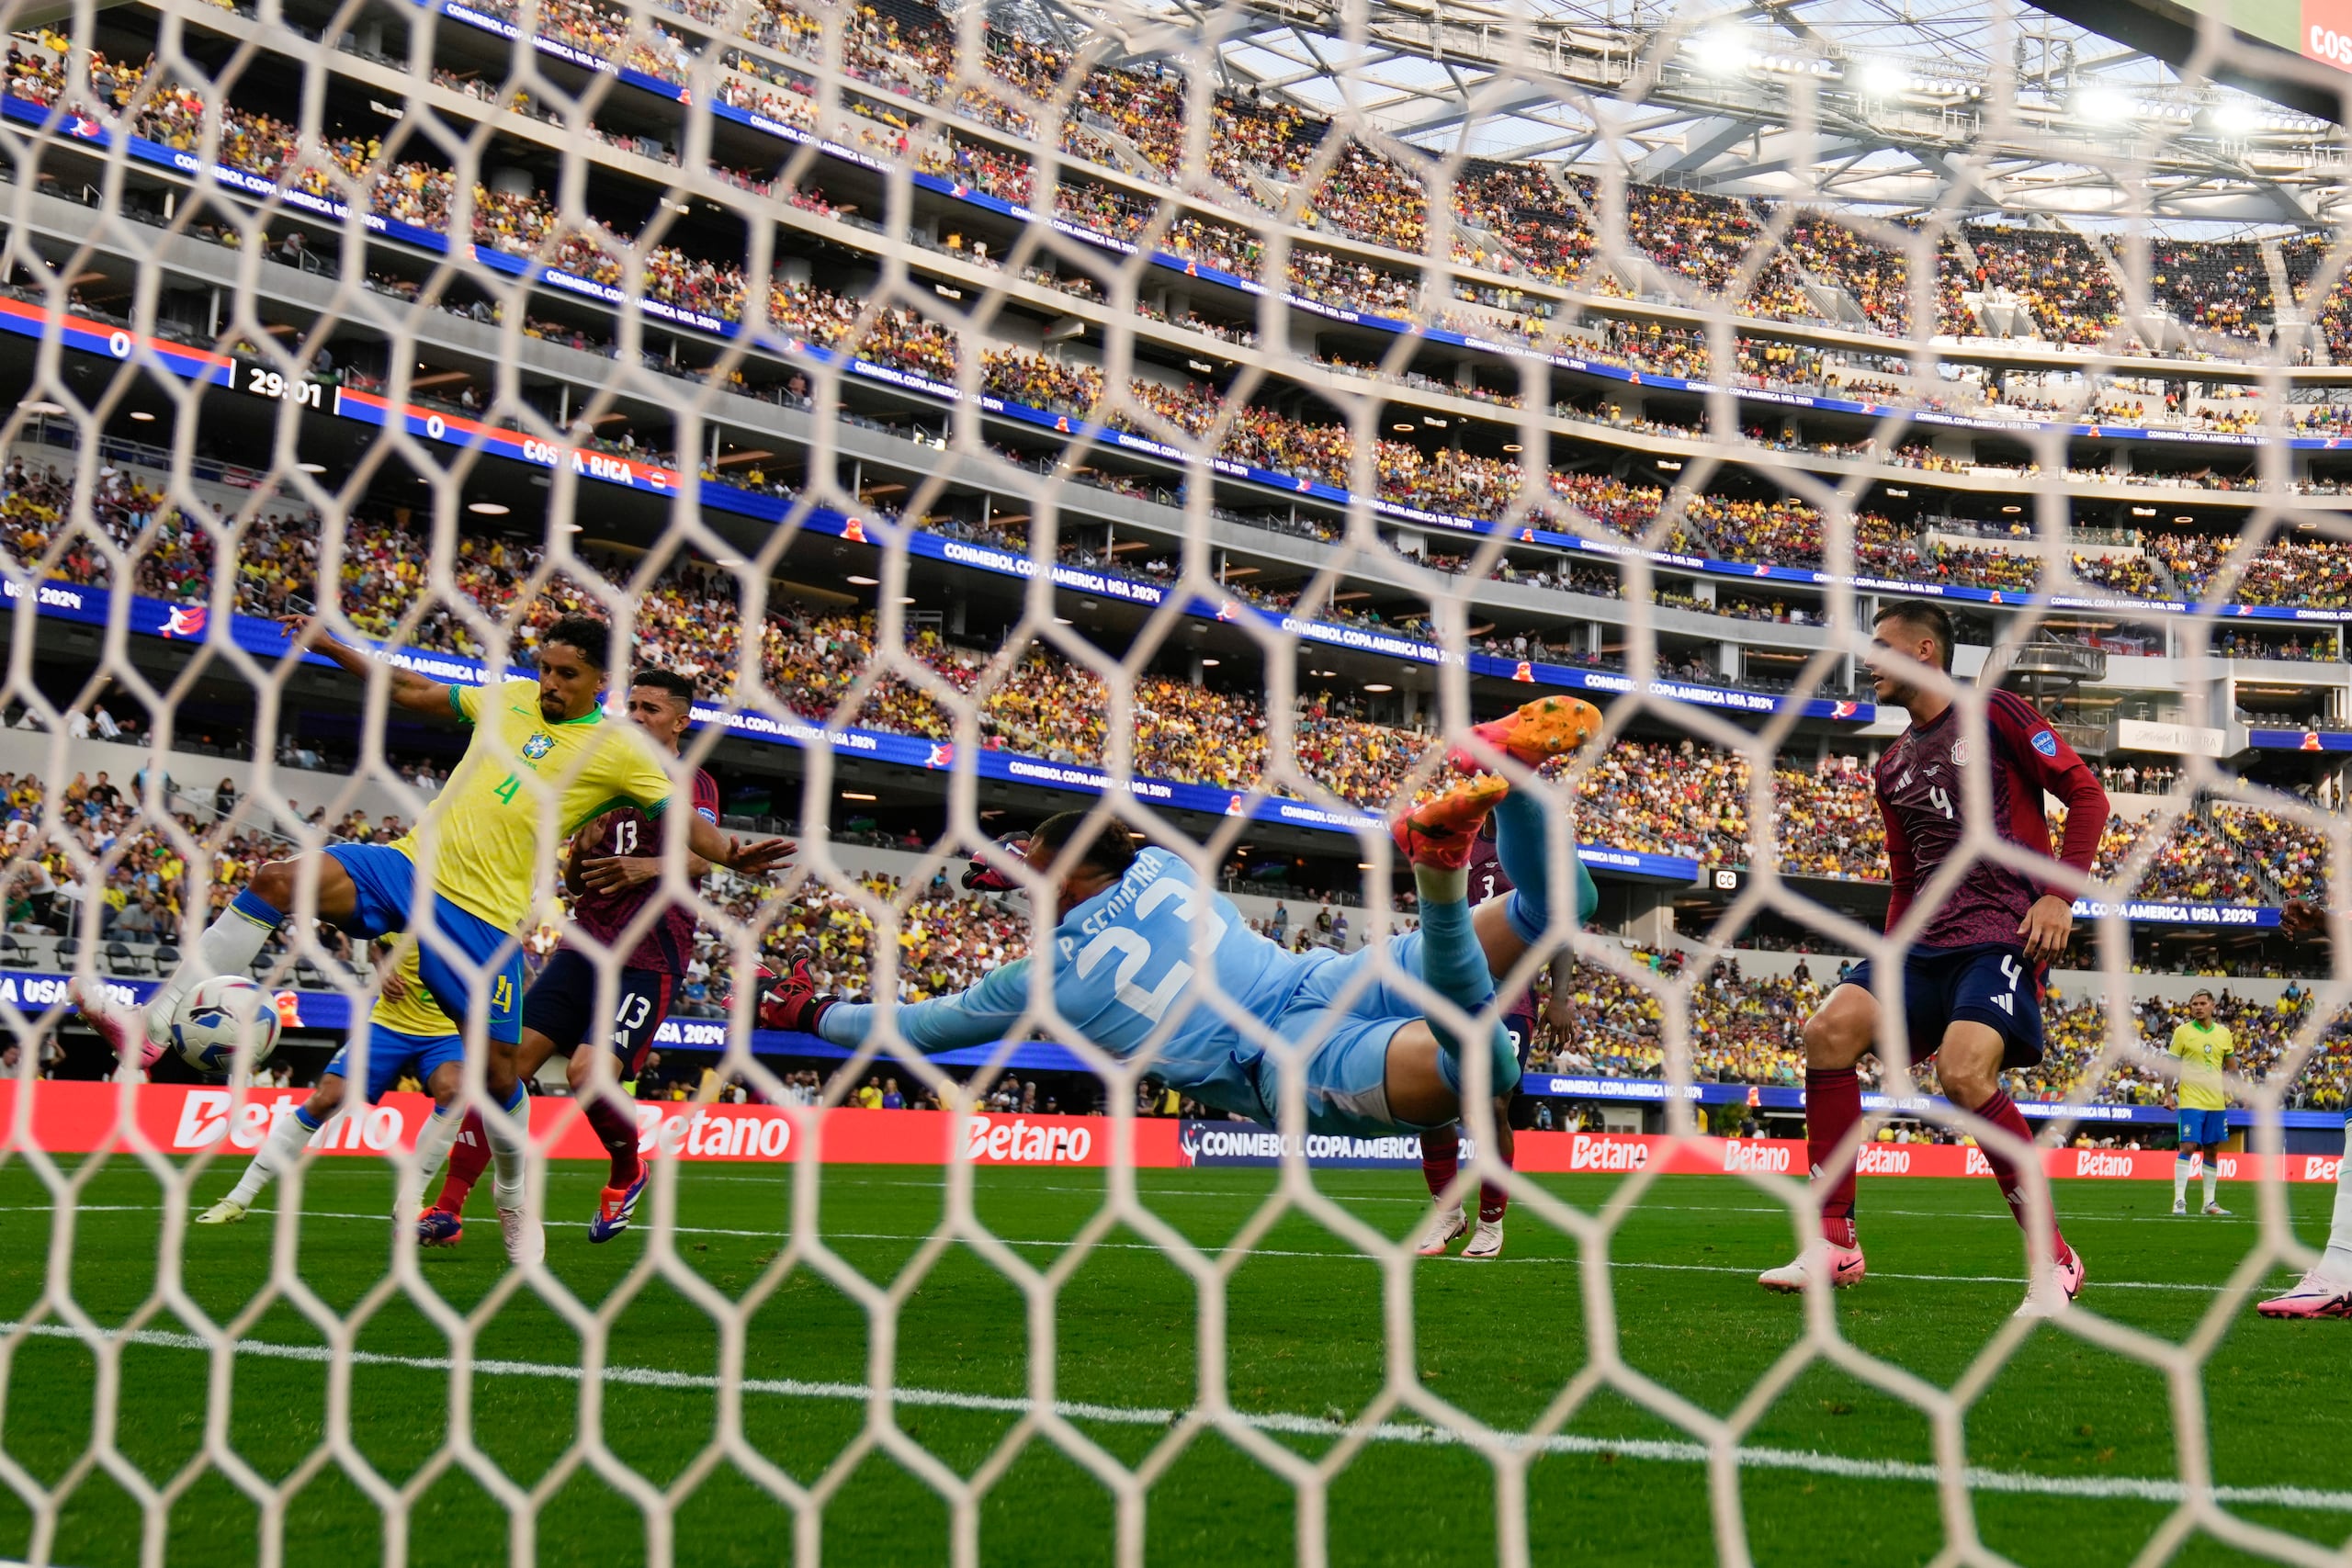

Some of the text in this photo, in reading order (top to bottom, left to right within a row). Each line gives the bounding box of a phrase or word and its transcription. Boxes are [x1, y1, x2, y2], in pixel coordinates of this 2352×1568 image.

[447, 3, 504, 34] CONMEBOL
[531, 35, 576, 60] AMERICA
[574, 51, 595, 67] USA
[750, 115, 798, 141] CONMEBOL
[820, 139, 859, 162] AMERICA
[244, 178, 386, 231] COPA AMERICA USA 2024
[1053, 220, 1075, 237] COPA
[1073, 227, 1105, 244] AMERICA
[1105, 236, 1121, 249] USA
[547, 270, 605, 297] CONMEBOL
[634, 297, 676, 319] AMERICA
[676, 309, 696, 324] USA
[695, 314, 721, 332] 2024
[1279, 292, 1359, 321] COPA AMERICA USA 2024
[109, 332, 130, 357] 0
[1464, 337, 1505, 353] CONMEBOL
[248, 367, 322, 408] 29:01
[854, 361, 1004, 411] CONMEBOL COPA AMERICA 2024
[1728, 388, 1814, 405] COPA AMERICA USA 2024
[426, 415, 446, 439] 0
[1916, 412, 1954, 423] CONMEBOL
[1953, 416, 1973, 426] COPA
[2147, 431, 2188, 440] CONMEBOL
[2207, 434, 2241, 443] AMERICA
[1118, 434, 1250, 476] CONMEBOL COPA USA 2024
[590, 456, 634, 485] RICA
[1386, 504, 1474, 528] COPA AMERICA USA 2024
[1579, 539, 1621, 554] CONMEBOL
[1671, 556, 1687, 565] USA
[1686, 558, 1704, 568] 2024
[944, 542, 1016, 575] CONMEBOL
[1051, 568, 1104, 592] AMERICA
[1106, 580, 1131, 596] USA
[1132, 584, 1160, 603] 2024
[1855, 578, 1944, 594] COPA AMERICA USA 2024
[40, 586, 82, 610] 2024
[2051, 597, 2095, 606] CONMEBOL
[2151, 602, 2166, 610] USA
[2166, 604, 2186, 612] 2024
[2296, 610, 2339, 620] CONMEBOL
[1282, 617, 1440, 661] CONMEBOL COPA AMERICA USA
[414, 659, 473, 681] AMERICA
[1585, 674, 1773, 710] CONMEBO COPA AMERICA USA 2024
[689, 706, 746, 728] ONMEBOL
[745, 716, 776, 734] COPA
[775, 722, 825, 739] AMERICA
[850, 734, 876, 750] 2024
[493, 772, 521, 805] 4
[1009, 761, 1172, 798] CONMEBOL COPA USA 2024
[1281, 805, 1327, 822] CONMEBOL
[1327, 813, 1354, 825] COPA
[1929, 785, 1954, 819] 4
[614, 820, 639, 855] 13
[1480, 874, 1496, 904] 3
[1719, 874, 1734, 886] CC
[2128, 905, 2188, 920] AMERICA
[2190, 907, 2220, 922] USA
[2221, 908, 2257, 923] 2024
[1077, 877, 1228, 1027] 23
[2000, 954, 2023, 992] 4
[492, 975, 513, 1013] 4
[616, 992, 651, 1029] 13
[656, 1021, 725, 1045] SA 2024
[1550, 1078, 1703, 1099] CONMEBOL COPA AMERICA 2024
[173, 1089, 404, 1150] Betno
[2098, 1108, 2112, 1118] USA
[2111, 1109, 2132, 1119] 2024
[1306, 1134, 1354, 1157] COPA
[1352, 1137, 1423, 1159] AMERICA
[1570, 1135, 1648, 1169] Betano
[1724, 1140, 1791, 1171] Betano
[1856, 1145, 1910, 1173] Betano
[2076, 1150, 2132, 1177] Betano
